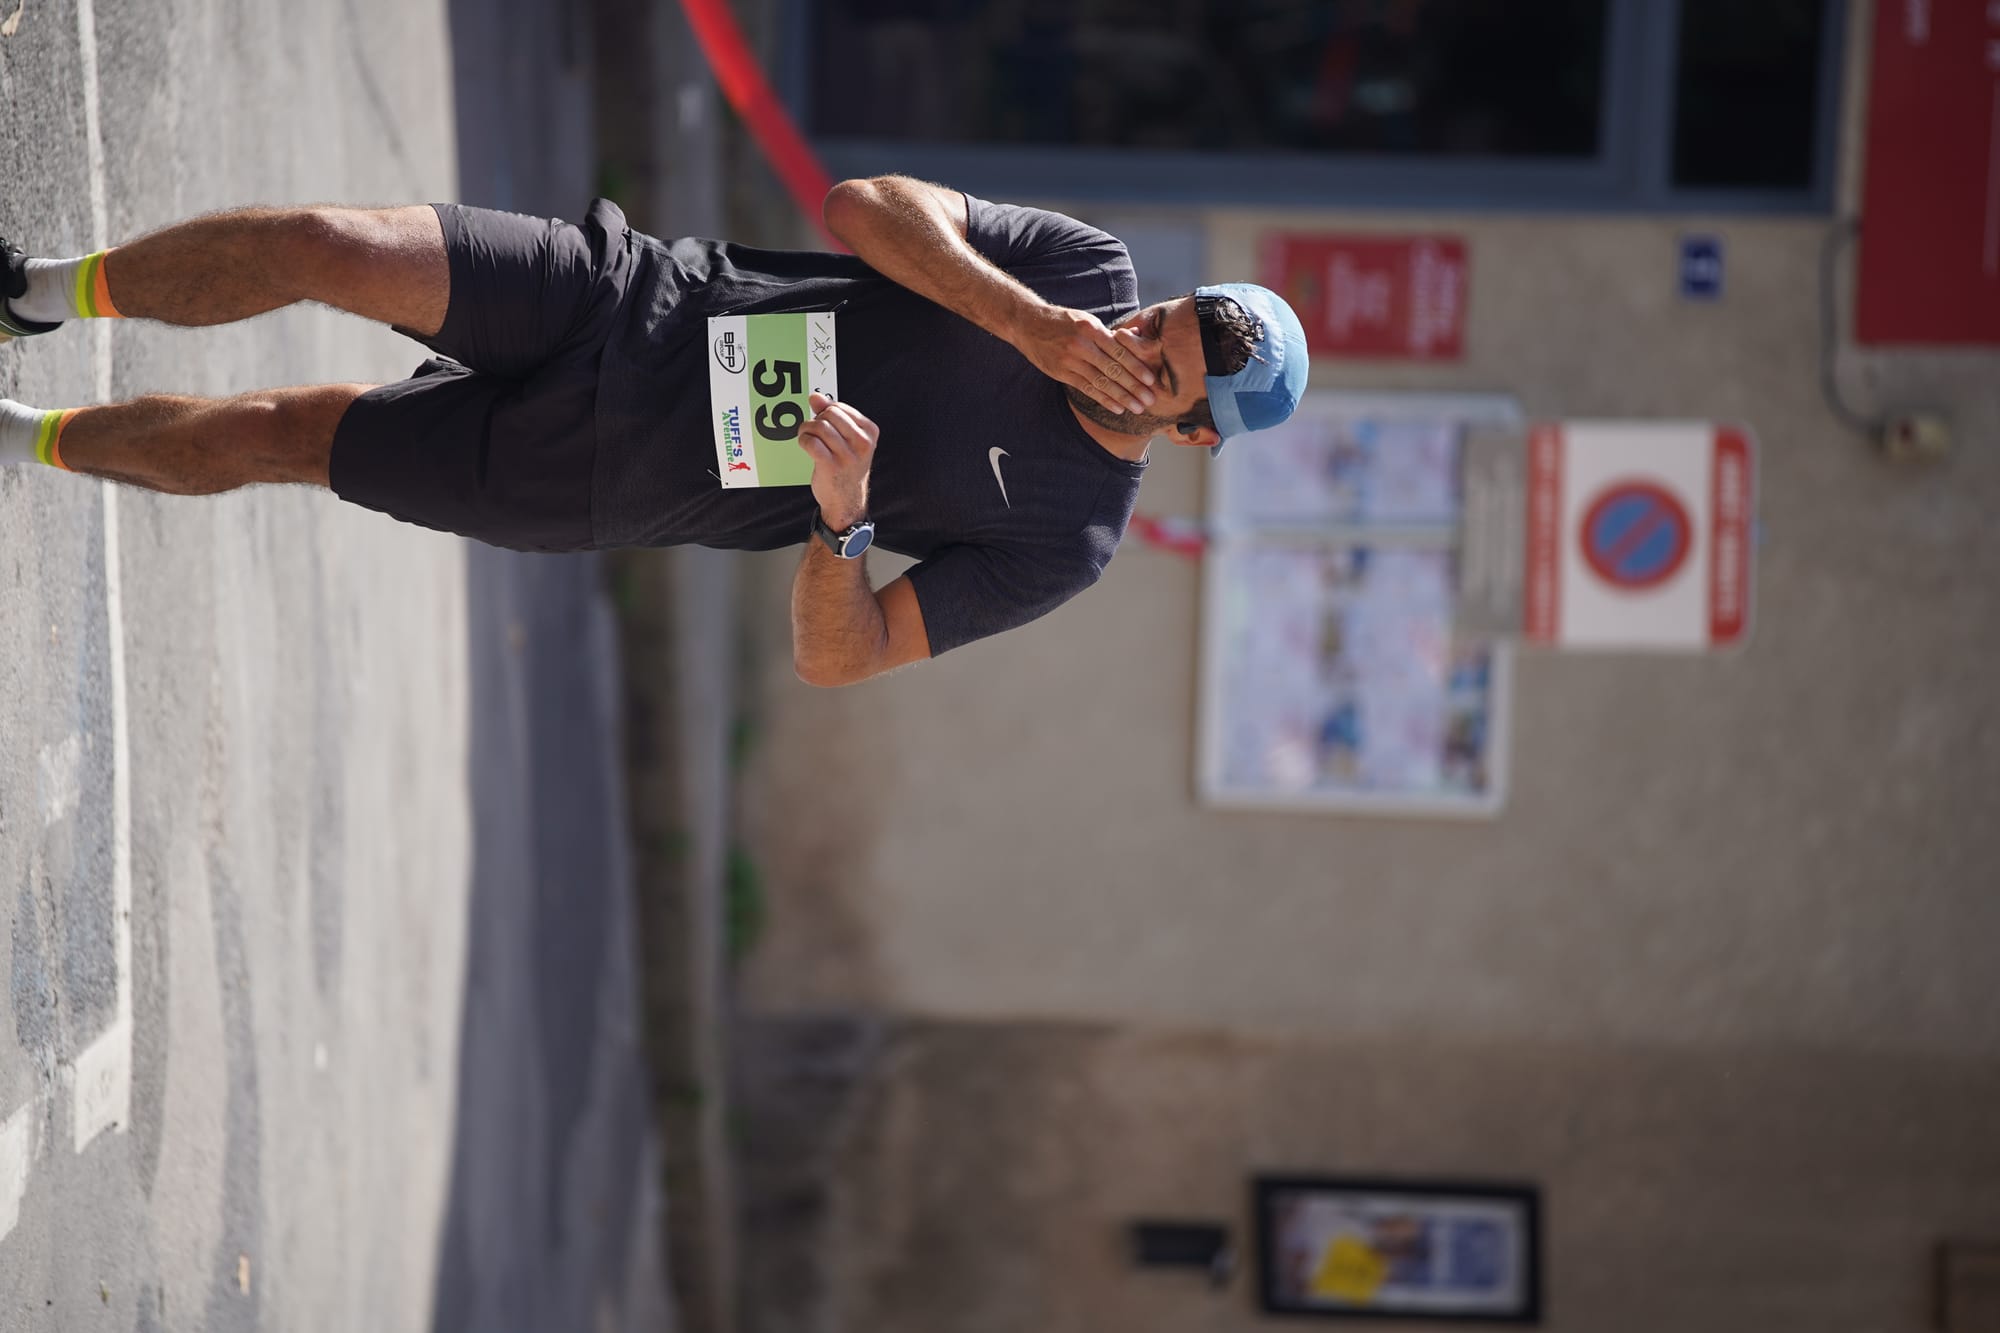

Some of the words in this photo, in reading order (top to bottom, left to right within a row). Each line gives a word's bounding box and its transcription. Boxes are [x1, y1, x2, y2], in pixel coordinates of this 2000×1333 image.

[724, 332, 735, 368] BFP
[752, 359, 804, 441] 59
[722, 412, 735, 462] Aventure
[729, 406, 742, 457] TUFF'S
